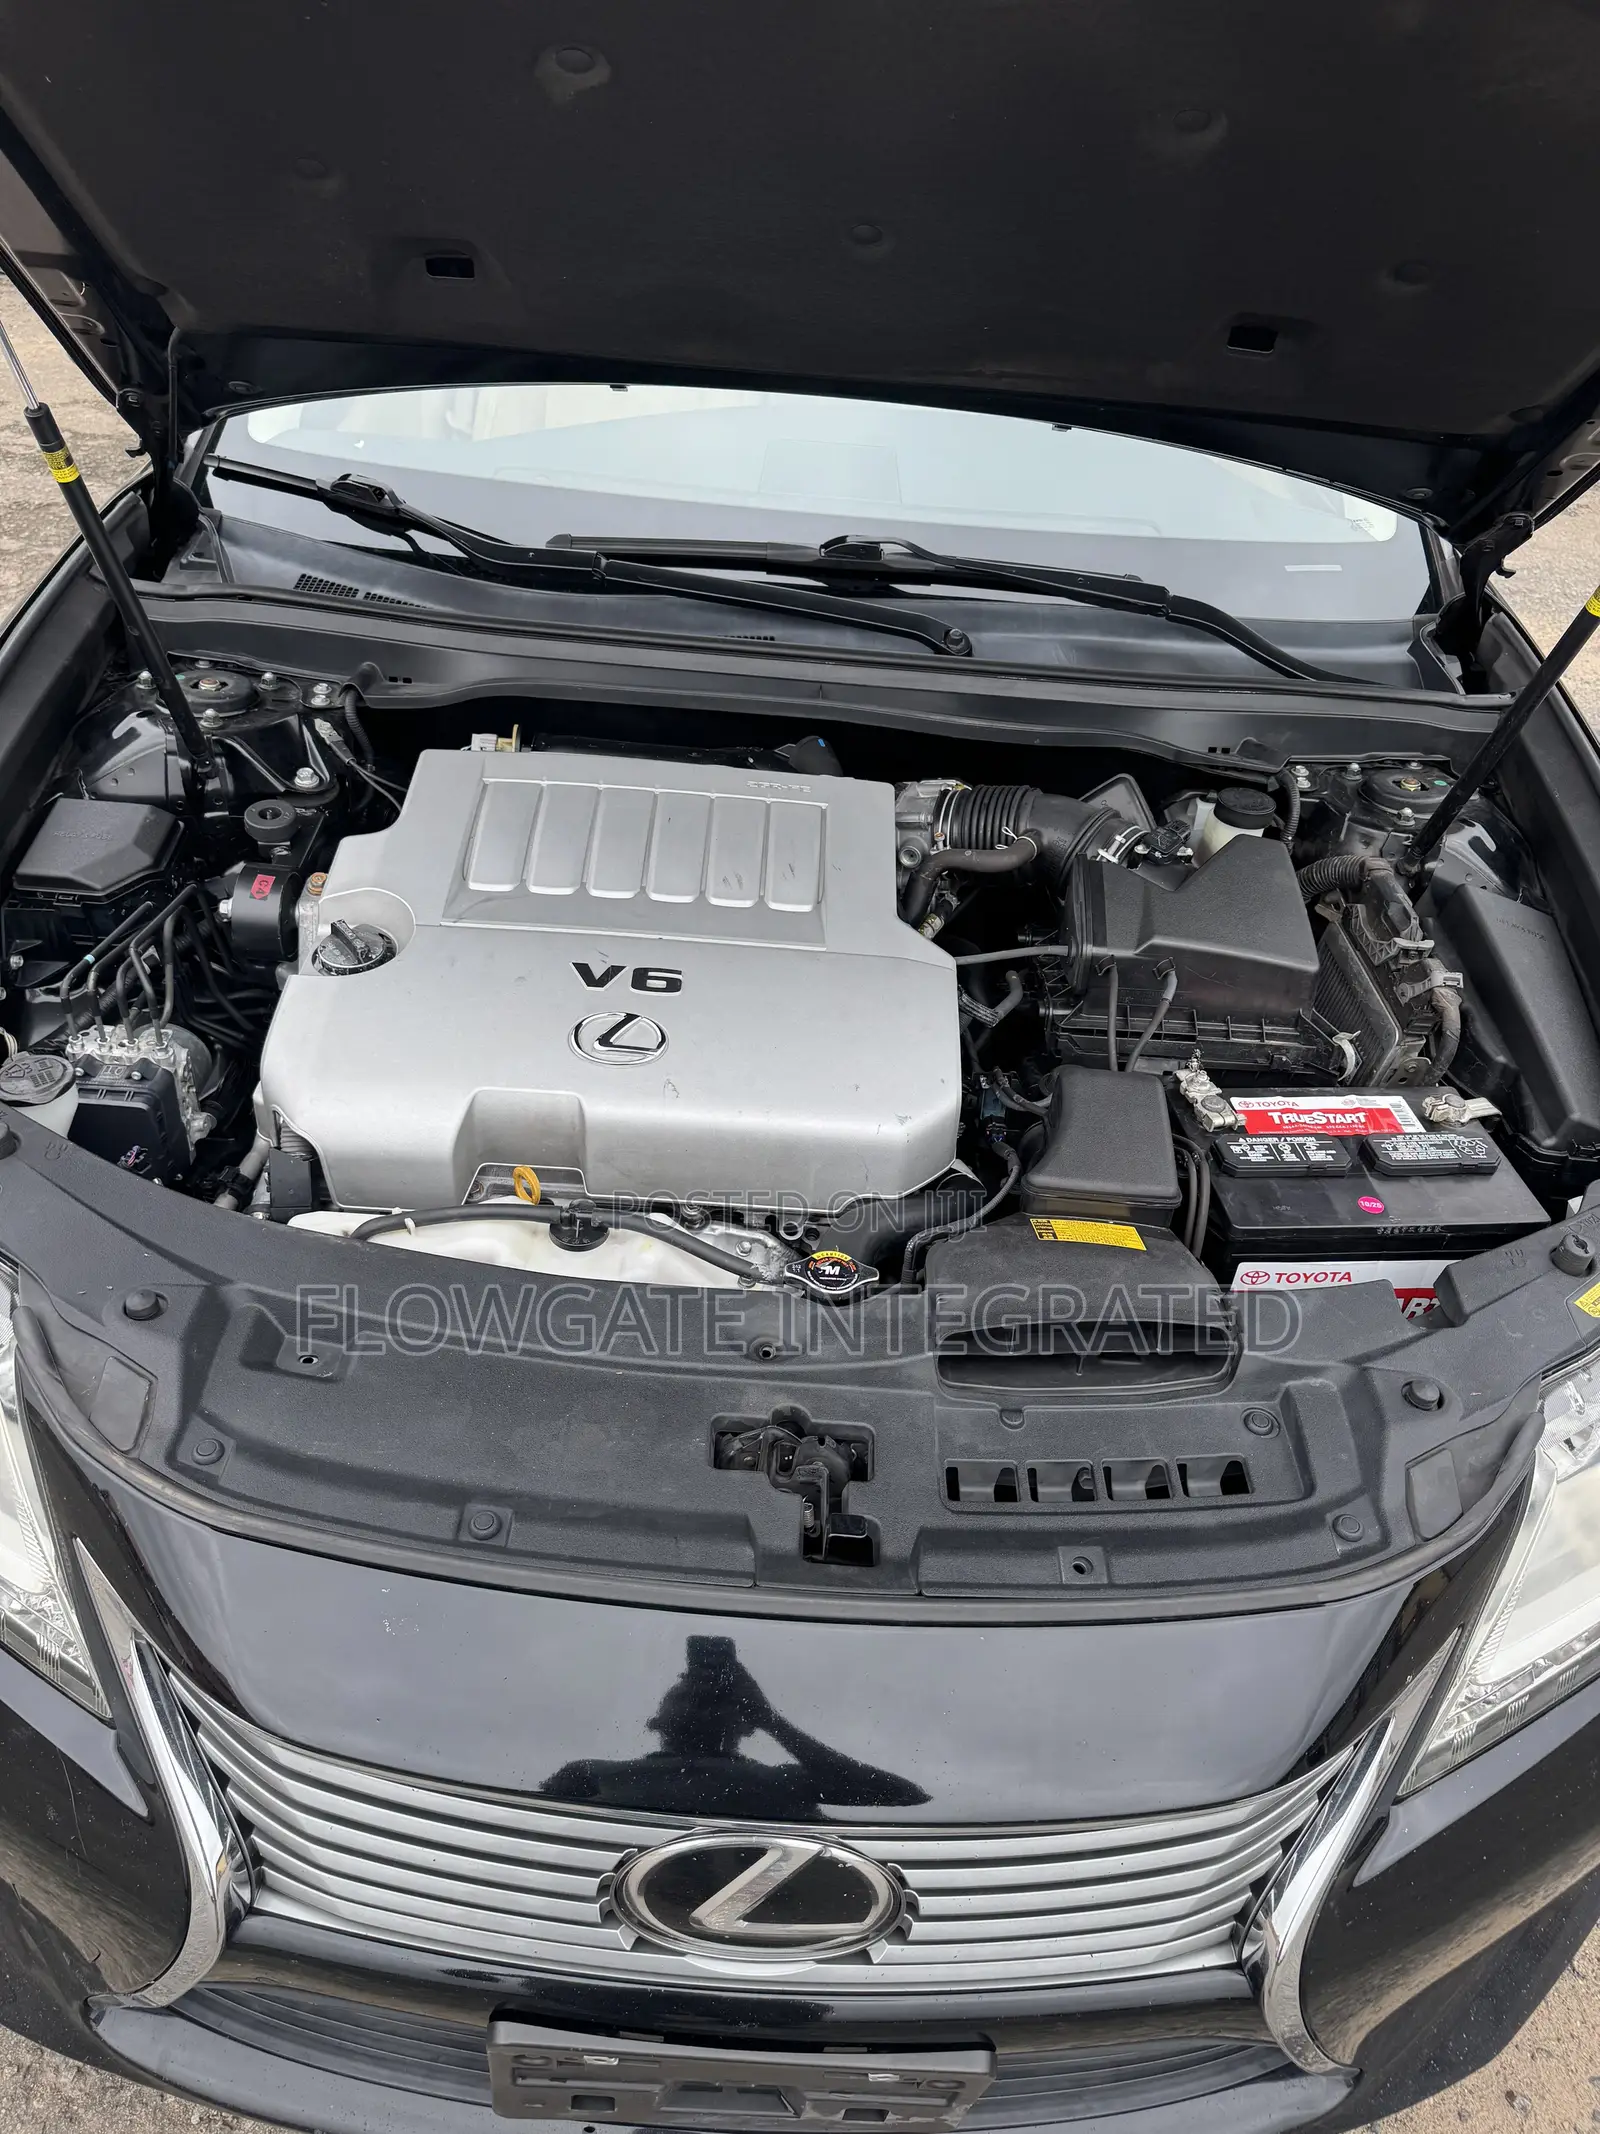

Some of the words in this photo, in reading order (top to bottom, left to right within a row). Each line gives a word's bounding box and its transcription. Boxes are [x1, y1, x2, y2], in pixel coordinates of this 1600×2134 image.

[569, 961, 683, 996] V6
[1255, 1100, 1299, 1108] TOYOTA
[1274, 1271, 1352, 1284] TOYOTA
